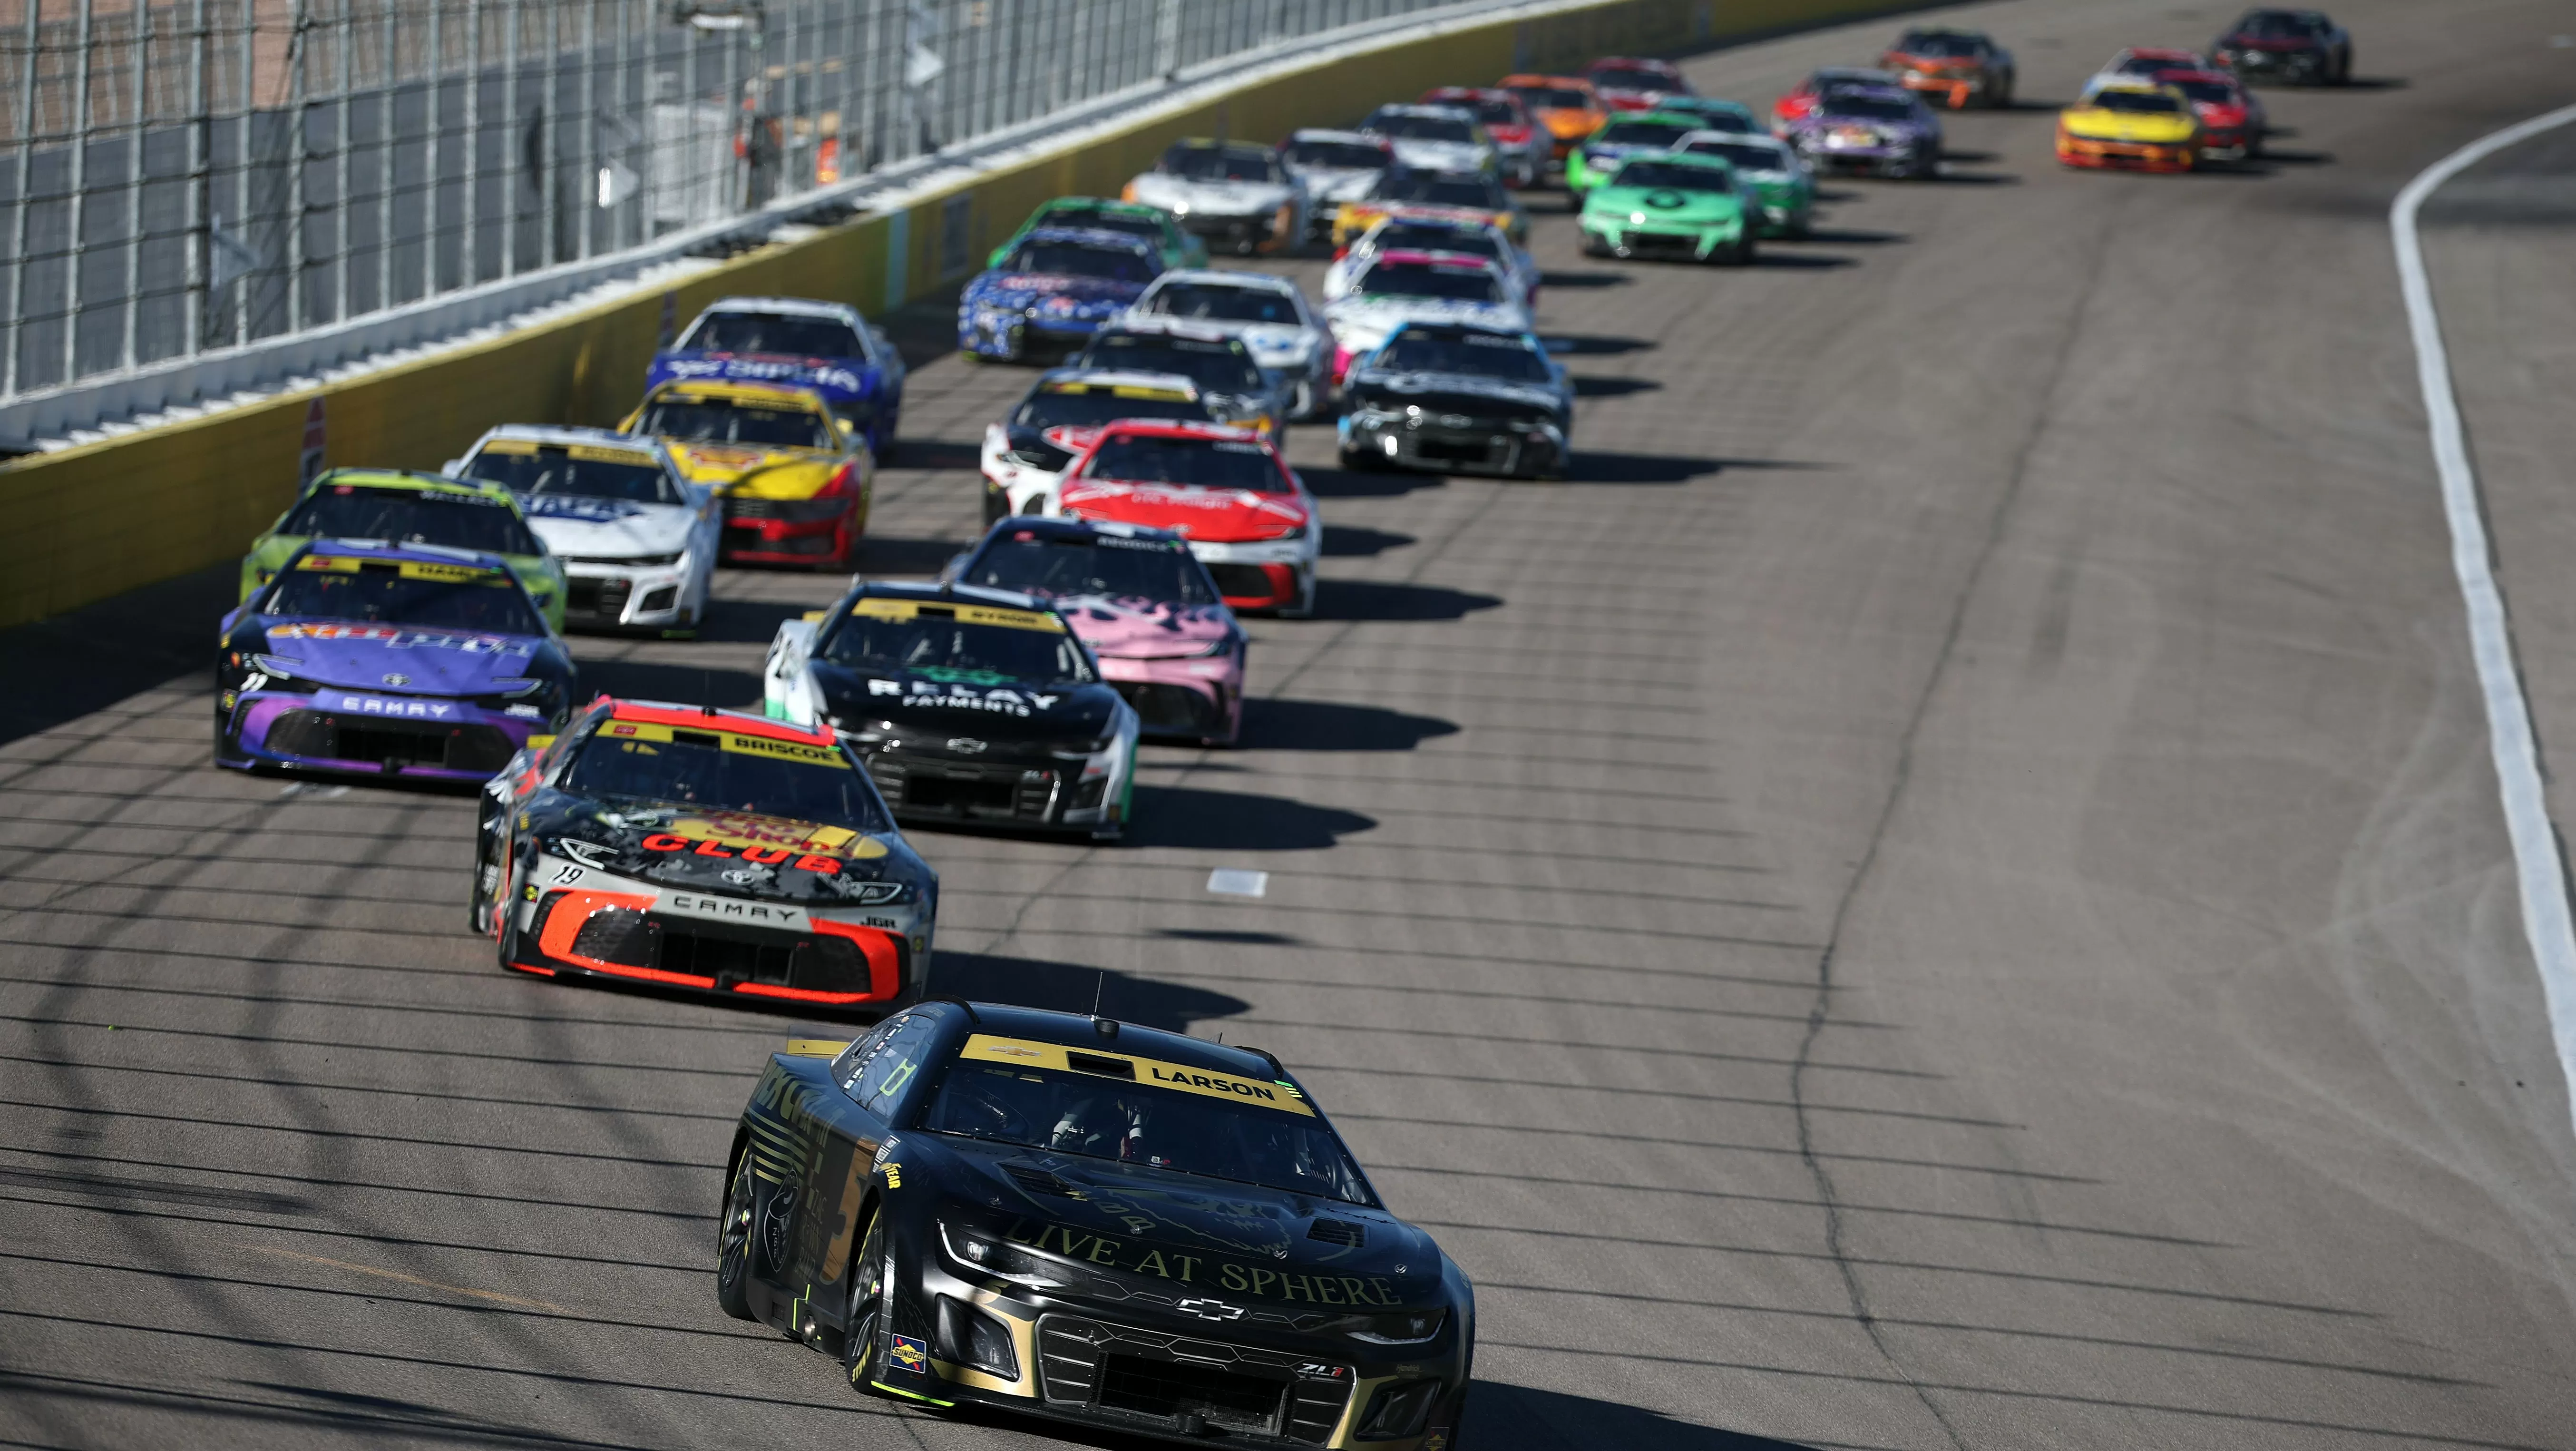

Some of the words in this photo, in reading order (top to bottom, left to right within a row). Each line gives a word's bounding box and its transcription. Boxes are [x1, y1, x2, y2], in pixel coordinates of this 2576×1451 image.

[867, 678, 1060, 710] RELAY
[342, 696, 451, 718] CAMRY
[903, 695, 1031, 717] PAYMENTS
[734, 737, 835, 761] BRISCOE
[642, 833, 842, 874] CLUB
[549, 863, 586, 886] 19
[673, 895, 798, 922] CAMRY
[860, 916, 897, 929] JGR
[1151, 1067, 1276, 1101] LARSON
[1004, 1217, 1121, 1266] LIVE
[1134, 1249, 1202, 1282] AT
[1220, 1263, 1403, 1305] SPHERE
[893, 1347, 924, 1361] SUNOCO
[1297, 1363, 1344, 1377] ZL1
